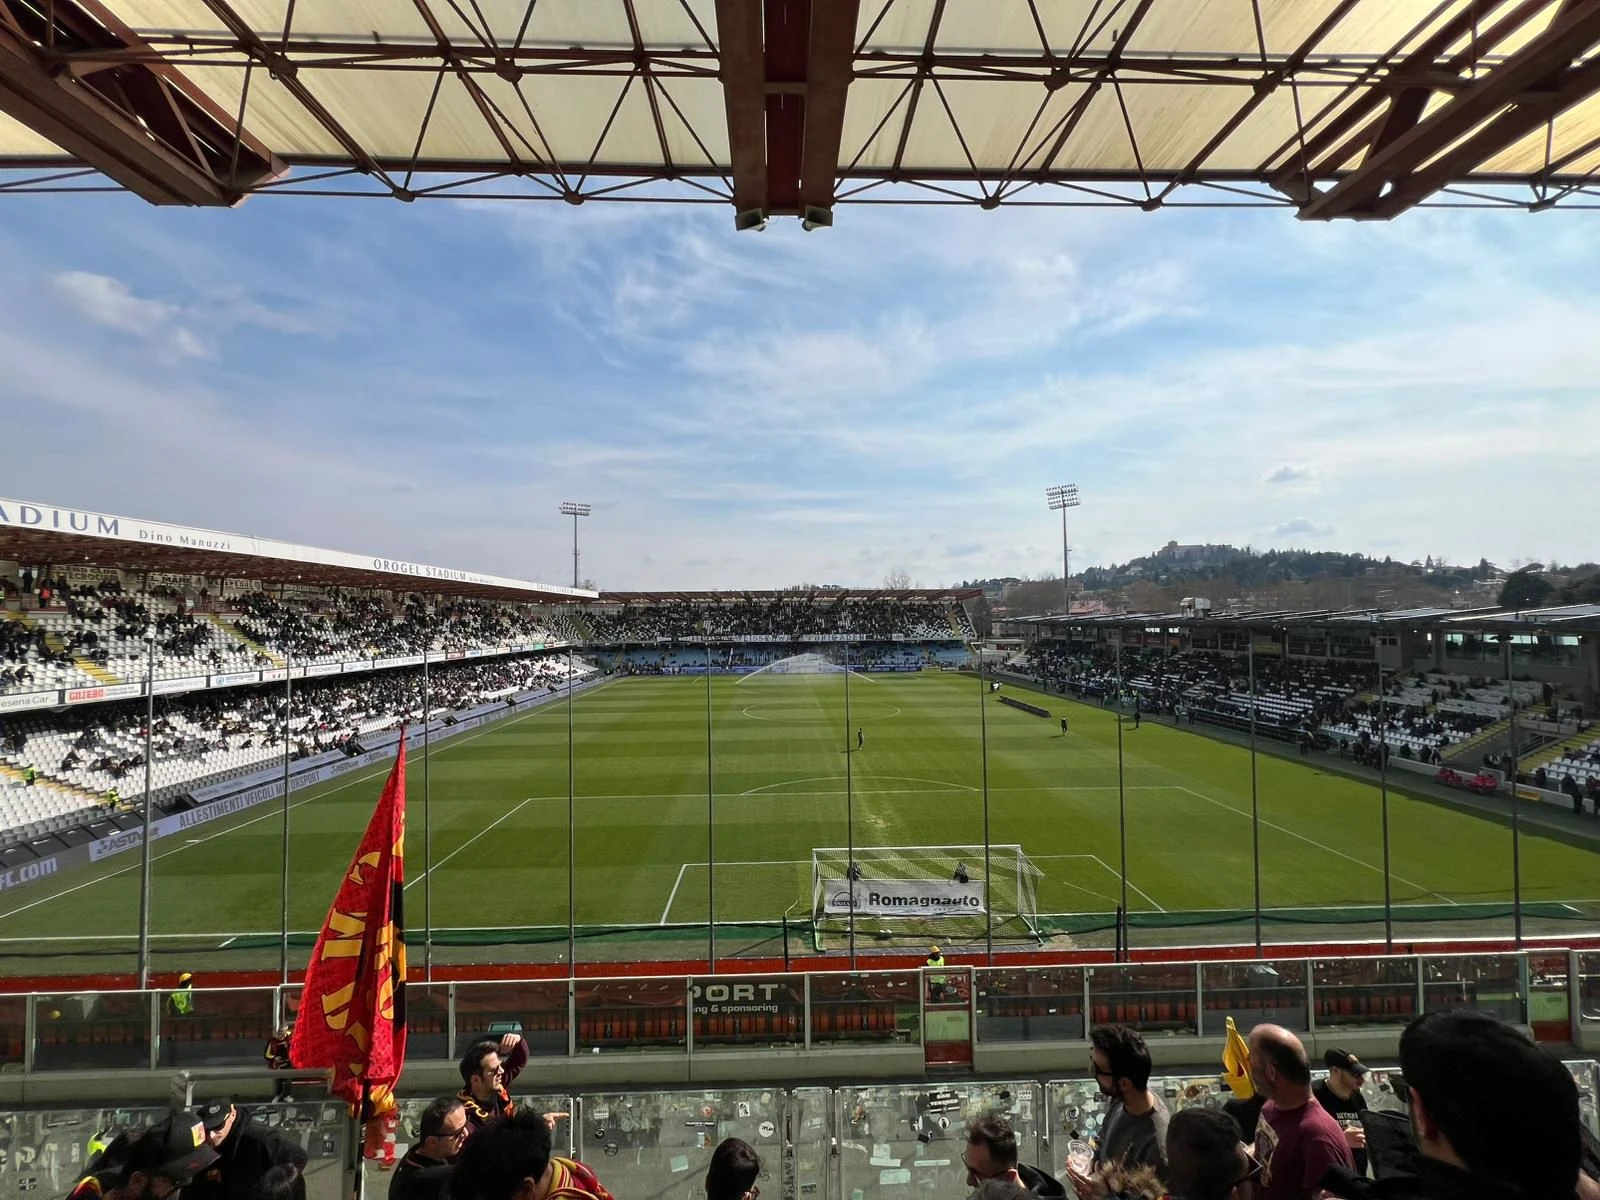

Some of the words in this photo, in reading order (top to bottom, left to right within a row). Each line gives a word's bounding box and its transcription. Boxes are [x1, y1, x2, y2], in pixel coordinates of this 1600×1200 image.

[139, 529, 172, 542] Dino
[179, 535, 230, 549] Manuzzi
[373, 558, 420, 575] OROGEL
[425, 566, 466, 581] STADIUM
[161, 575, 192, 584] MARE
[0, 697, 31, 708] esena
[32, 695, 49, 705] Car
[179, 794, 244, 828] ALLESTIMENTI
[244, 784, 276, 806] VEICOLI
[868, 892, 980, 907] Romagnauto
[710, 1004, 719, 1013] &
[721, 1003, 778, 1015] sponsoring
